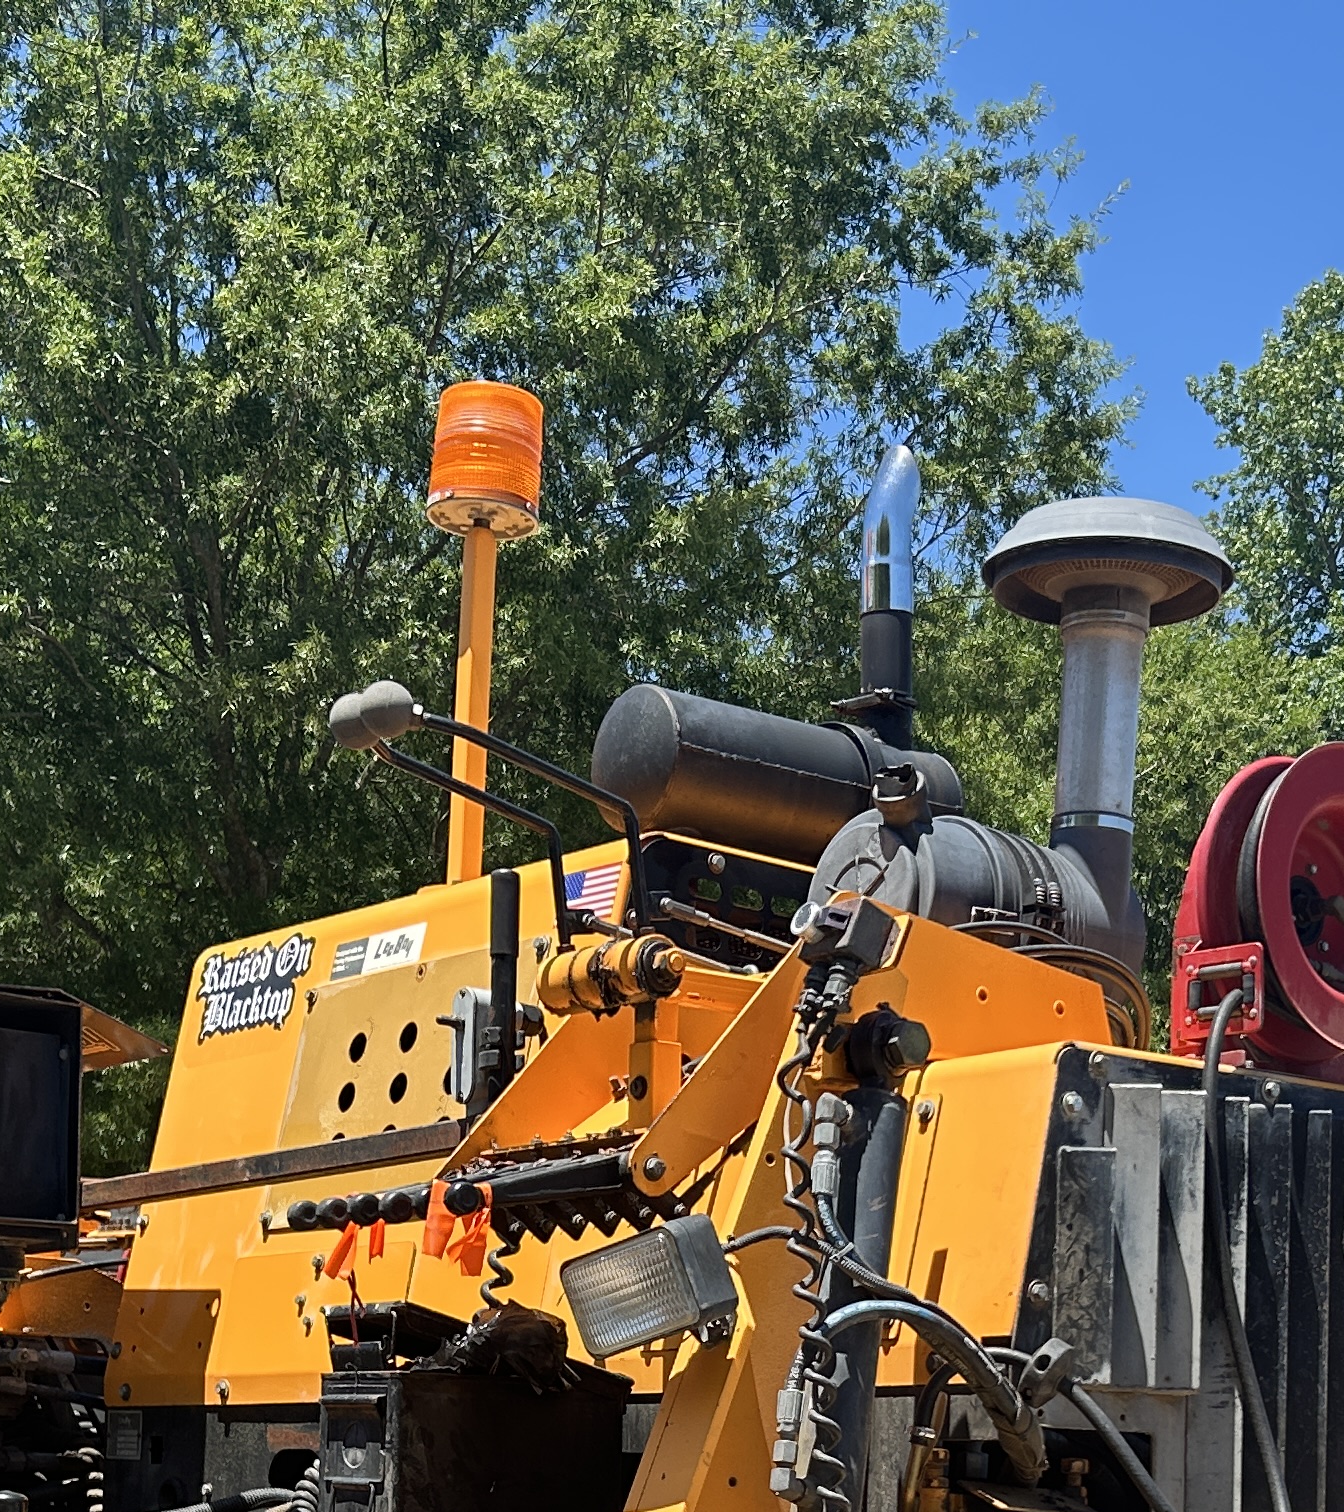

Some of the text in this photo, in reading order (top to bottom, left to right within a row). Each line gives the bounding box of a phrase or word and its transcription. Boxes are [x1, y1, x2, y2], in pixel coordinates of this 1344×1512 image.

[199, 945, 274, 995] Raised
[275, 935, 312, 977] On
[374, 933, 415, 960] LeeBoy
[200, 985, 294, 1039] Blacktop
